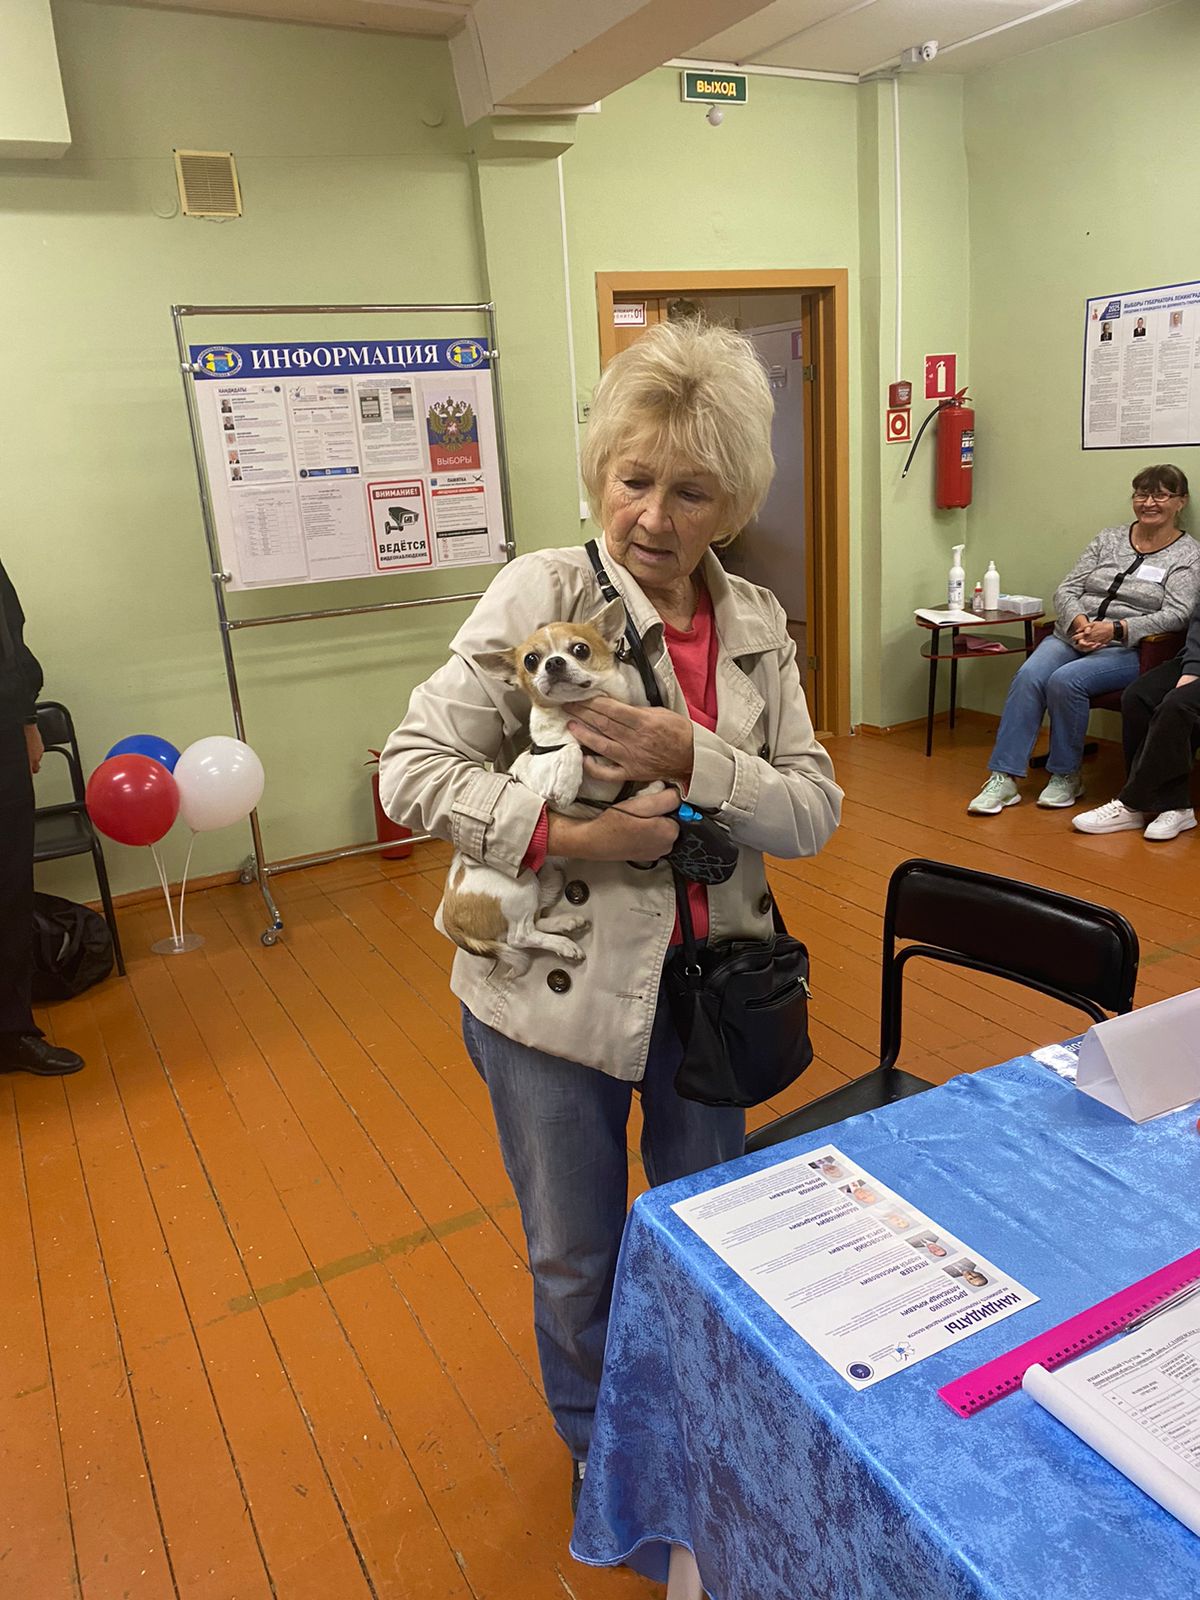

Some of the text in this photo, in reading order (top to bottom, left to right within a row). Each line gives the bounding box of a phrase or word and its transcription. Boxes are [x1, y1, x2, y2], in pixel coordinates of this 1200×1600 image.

[696, 80, 737, 97] ВЫХОД
[634, 308, 642, 319] 01
[251, 344, 440, 369] ИНФОРМАЦИЯ
[436, 456, 472, 466] ВЫБОРЫ
[375, 488, 418, 498] ВНИМАНИЕ!
[379, 540, 426, 554] ВЕДЁТСЯ
[380, 552, 427, 562] ВИДЕОНАБЛЮДЕНИЕ
[798, 1181, 827, 1196] НОВИКОВ
[853, 1232, 892, 1252] ЛИСОВСКИЙ
[860, 1265, 900, 1285] ЯРОСЛАВОВИЧ
[899, 1260, 929, 1276] ЛЕБЕДЕВ
[900, 1285, 960, 1316] АЛЕКСАНДР ЮРЬЕВИЧ
[929, 1290, 968, 1312] ДРОЗДЕНКО
[944, 1292, 1021, 1334] КАНДИДАТЫ
